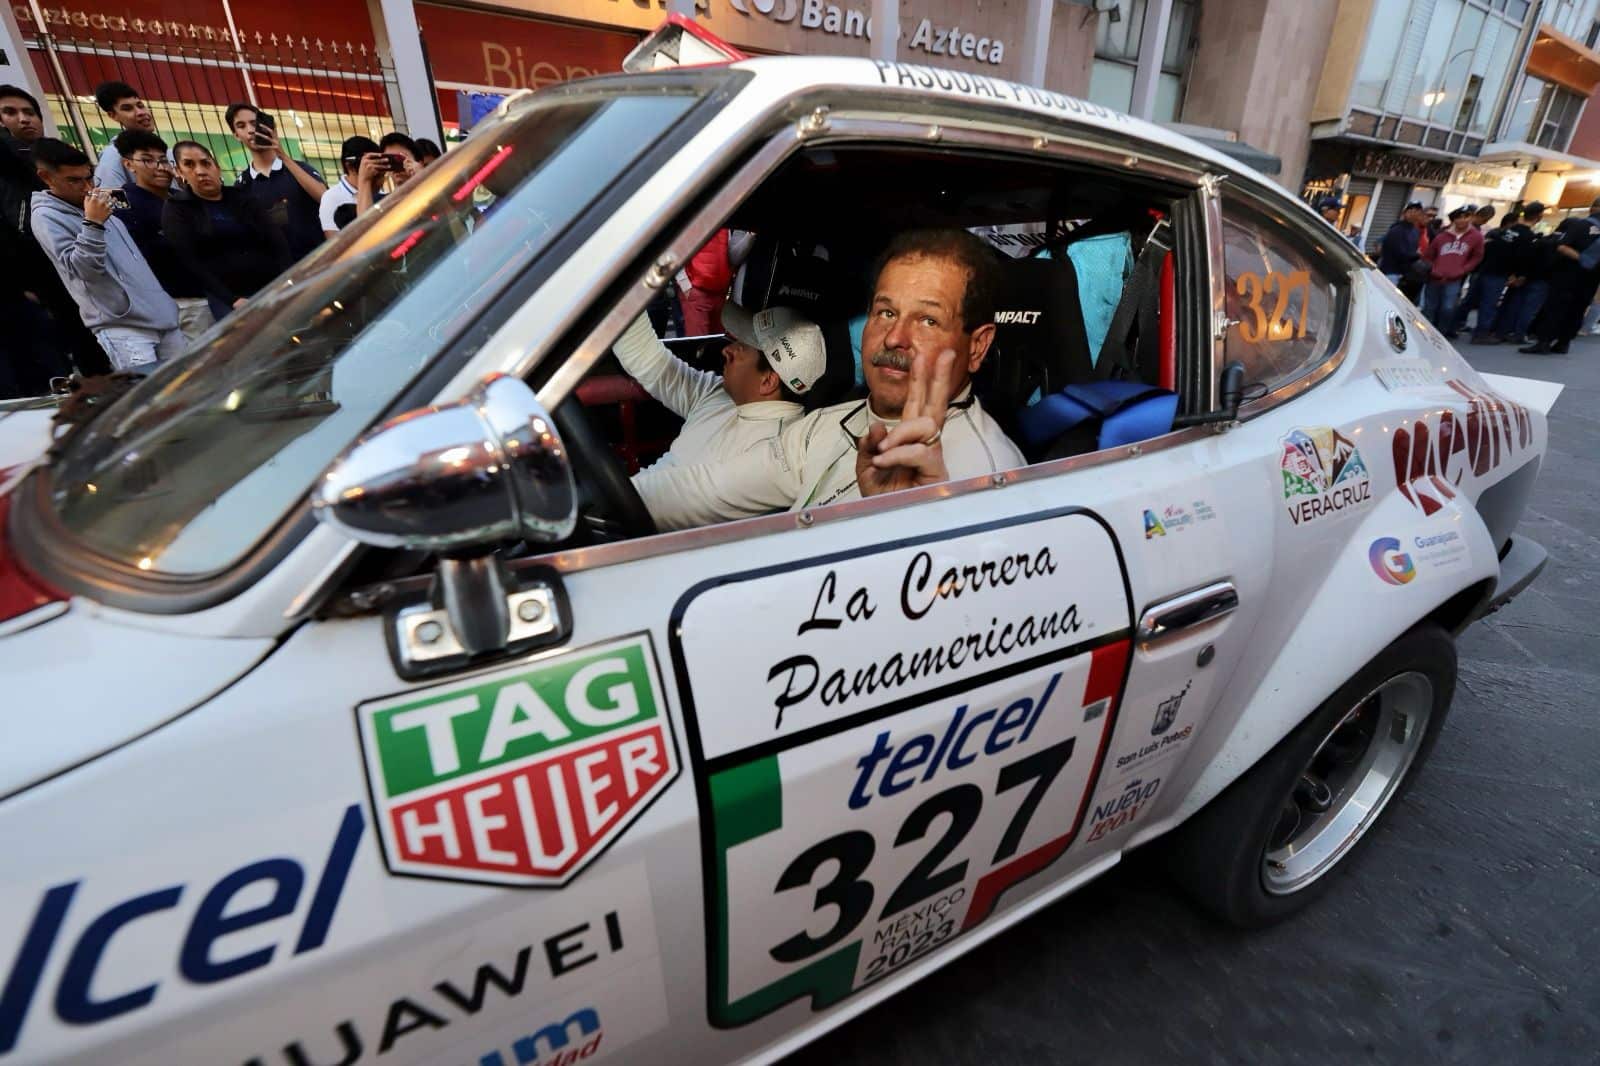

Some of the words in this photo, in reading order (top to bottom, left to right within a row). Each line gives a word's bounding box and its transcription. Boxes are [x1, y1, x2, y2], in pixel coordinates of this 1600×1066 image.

[801, 0, 899, 42] Banc
[909, 18, 1005, 65] Azteca
[994, 311, 1042, 325] MPACT
[1236, 271, 1311, 344] 327
[1288, 481, 1371, 526] VERACRUZ
[799, 571, 877, 637] La
[901, 547, 1058, 621] Carrera
[391, 656, 641, 778] TAG
[766, 603, 1083, 730] Panamericana
[847, 672, 1064, 811] telcel
[401, 732, 662, 872] HEUER
[769, 736, 1077, 964] 327
[242, 910, 625, 1066] UAWEI
[864, 923, 956, 980] 2023
